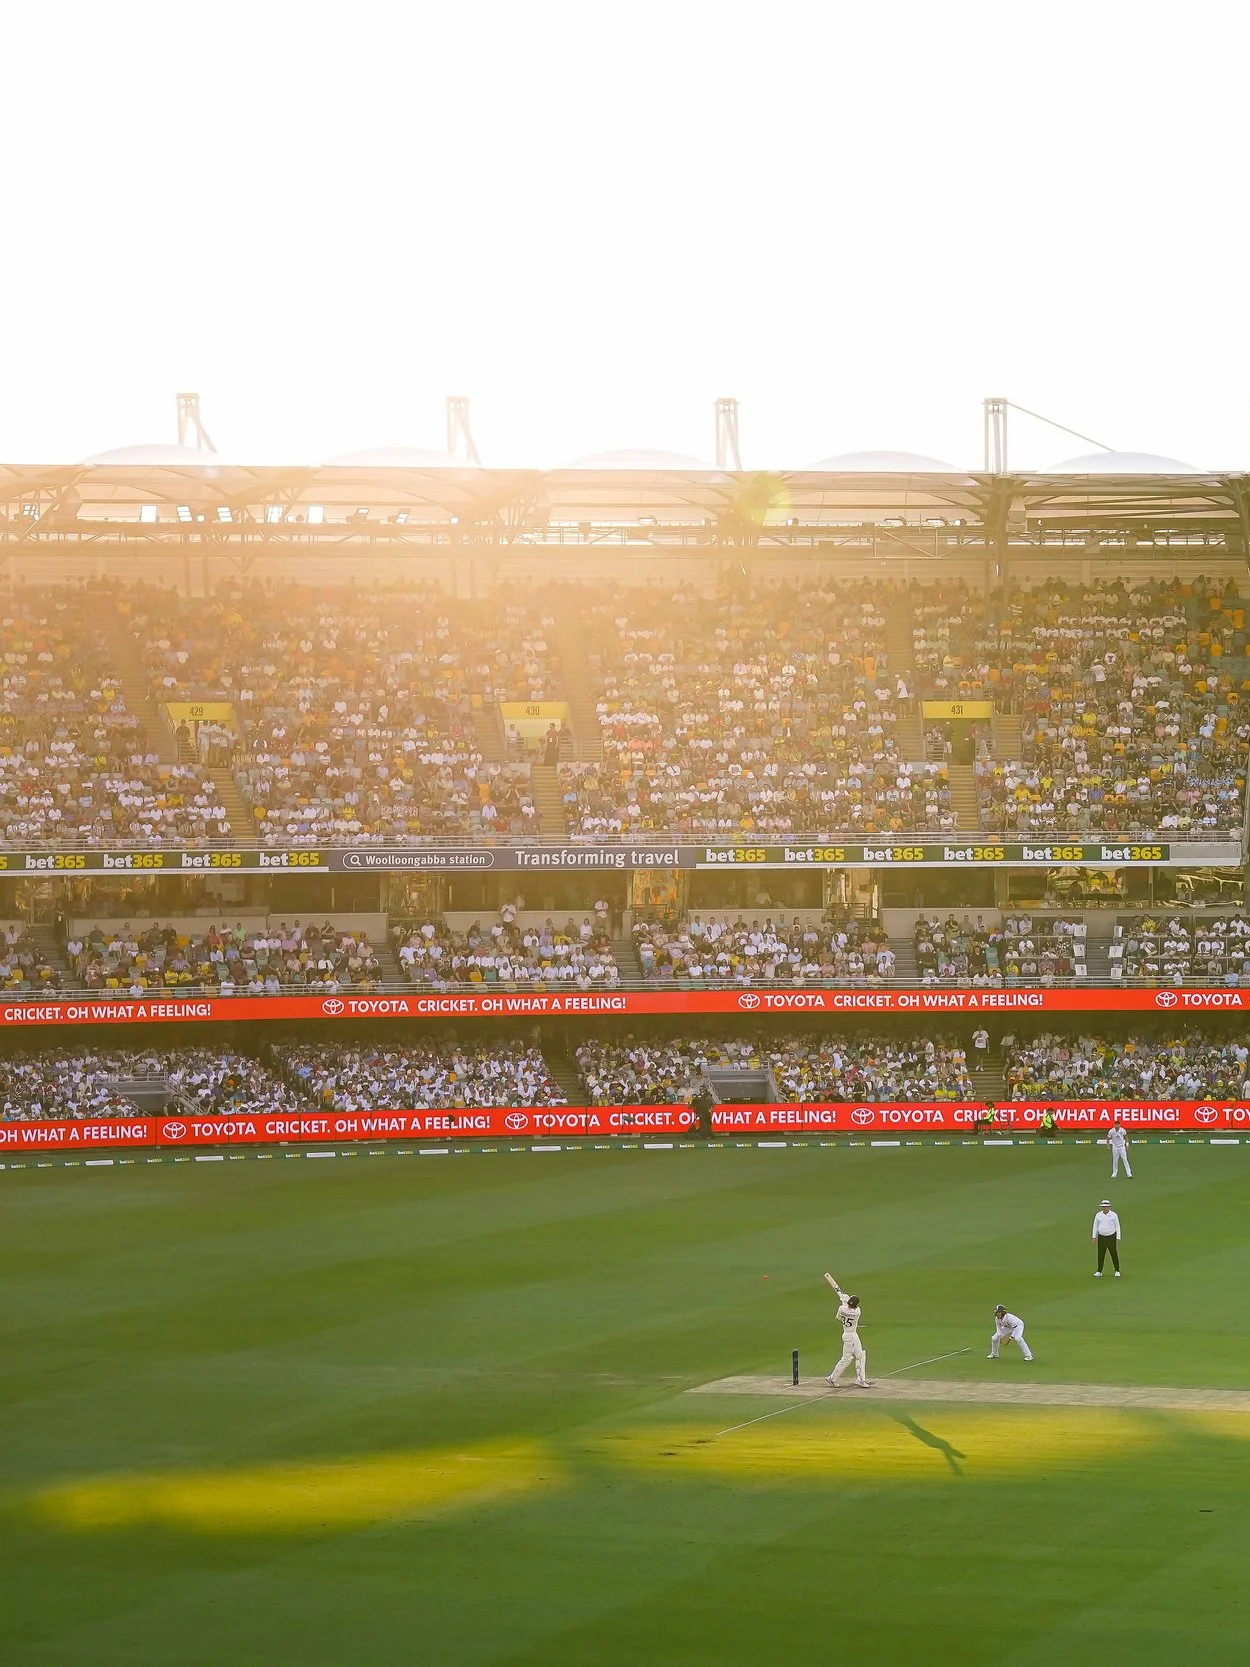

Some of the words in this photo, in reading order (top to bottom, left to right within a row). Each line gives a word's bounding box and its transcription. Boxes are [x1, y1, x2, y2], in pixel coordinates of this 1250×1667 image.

[190, 706, 204, 716] 429
[526, 706, 540, 716] 430
[951, 705, 963, 715] 431
[259, 852, 319, 867] bet365
[515, 850, 626, 867] Transforming
[630, 850, 679, 865] travel
[706, 848, 766, 862] bet365
[784, 848, 845, 862] bet365
[863, 847, 924, 862] bet365
[944, 847, 1004, 861] bet365
[1022, 847, 1083, 861] bet365
[1100, 846, 1162, 860] bet365
[25, 854, 85, 869] bet365
[103, 853, 163, 868] bet365
[181, 853, 241, 868] bet365
[365, 854, 446, 867] Woolloongabba
[449, 854, 485, 865] station
[765, 995, 824, 1006] TOYOTA
[834, 995, 894, 1007] CRICKET.
[898, 995, 919, 1006] OH
[923, 995, 965, 1006] WHAT
[969, 995, 978, 1006] A
[982, 994, 1042, 1006] FEELING!
[4, 1008, 63, 1021] CRICKET.
[67, 1007, 88, 1019] OH
[92, 1006, 133, 1018] WHAT
[137, 1005, 147, 1017] A
[151, 1004, 211, 1017] FEELING!
[0, 1130, 18, 1142] OH
[22, 1128, 65, 1142] WHAT
[69, 1128, 80, 1140] A
[83, 1126, 147, 1139] FEELING!
